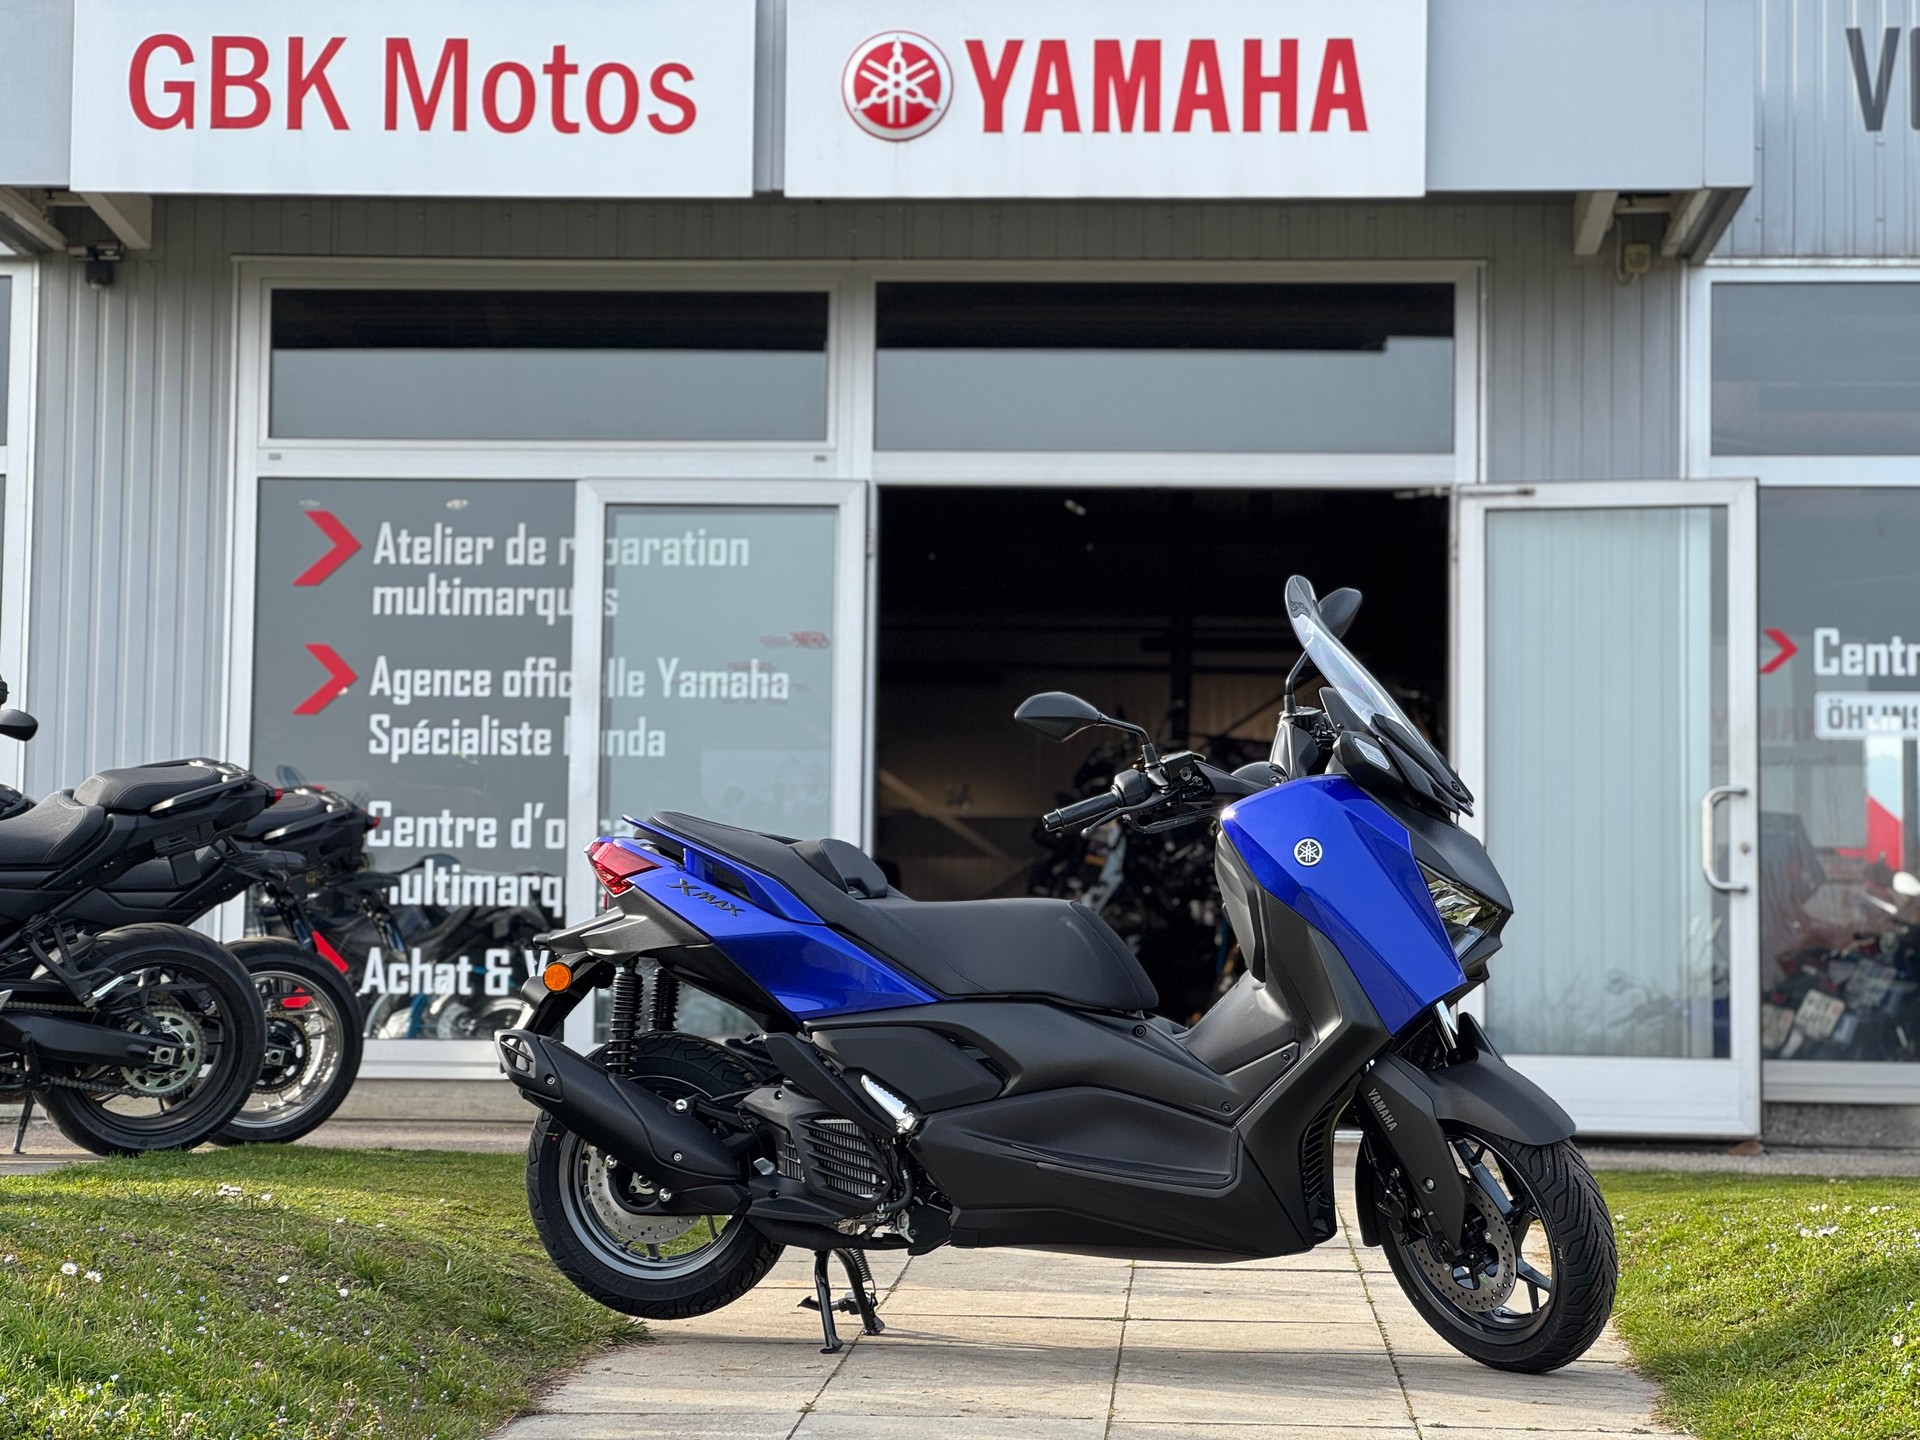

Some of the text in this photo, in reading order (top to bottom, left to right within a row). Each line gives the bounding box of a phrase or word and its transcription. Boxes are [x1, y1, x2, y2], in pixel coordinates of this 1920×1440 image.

[128, 33, 697, 134] GBK Motos
[964, 38, 1369, 133] YAMAHA
[373, 521, 494, 566] Atelier
[505, 522, 547, 566] de
[372, 573, 618, 626] multimarqus
[369, 655, 789, 705] Agence officlle Yamaha
[369, 713, 552, 763] Spécialiste
[366, 800, 498, 849] Centre
[360, 947, 472, 995] Achat
[485, 948, 513, 996] &
[1368, 1088, 1398, 1131] YAMAHA
